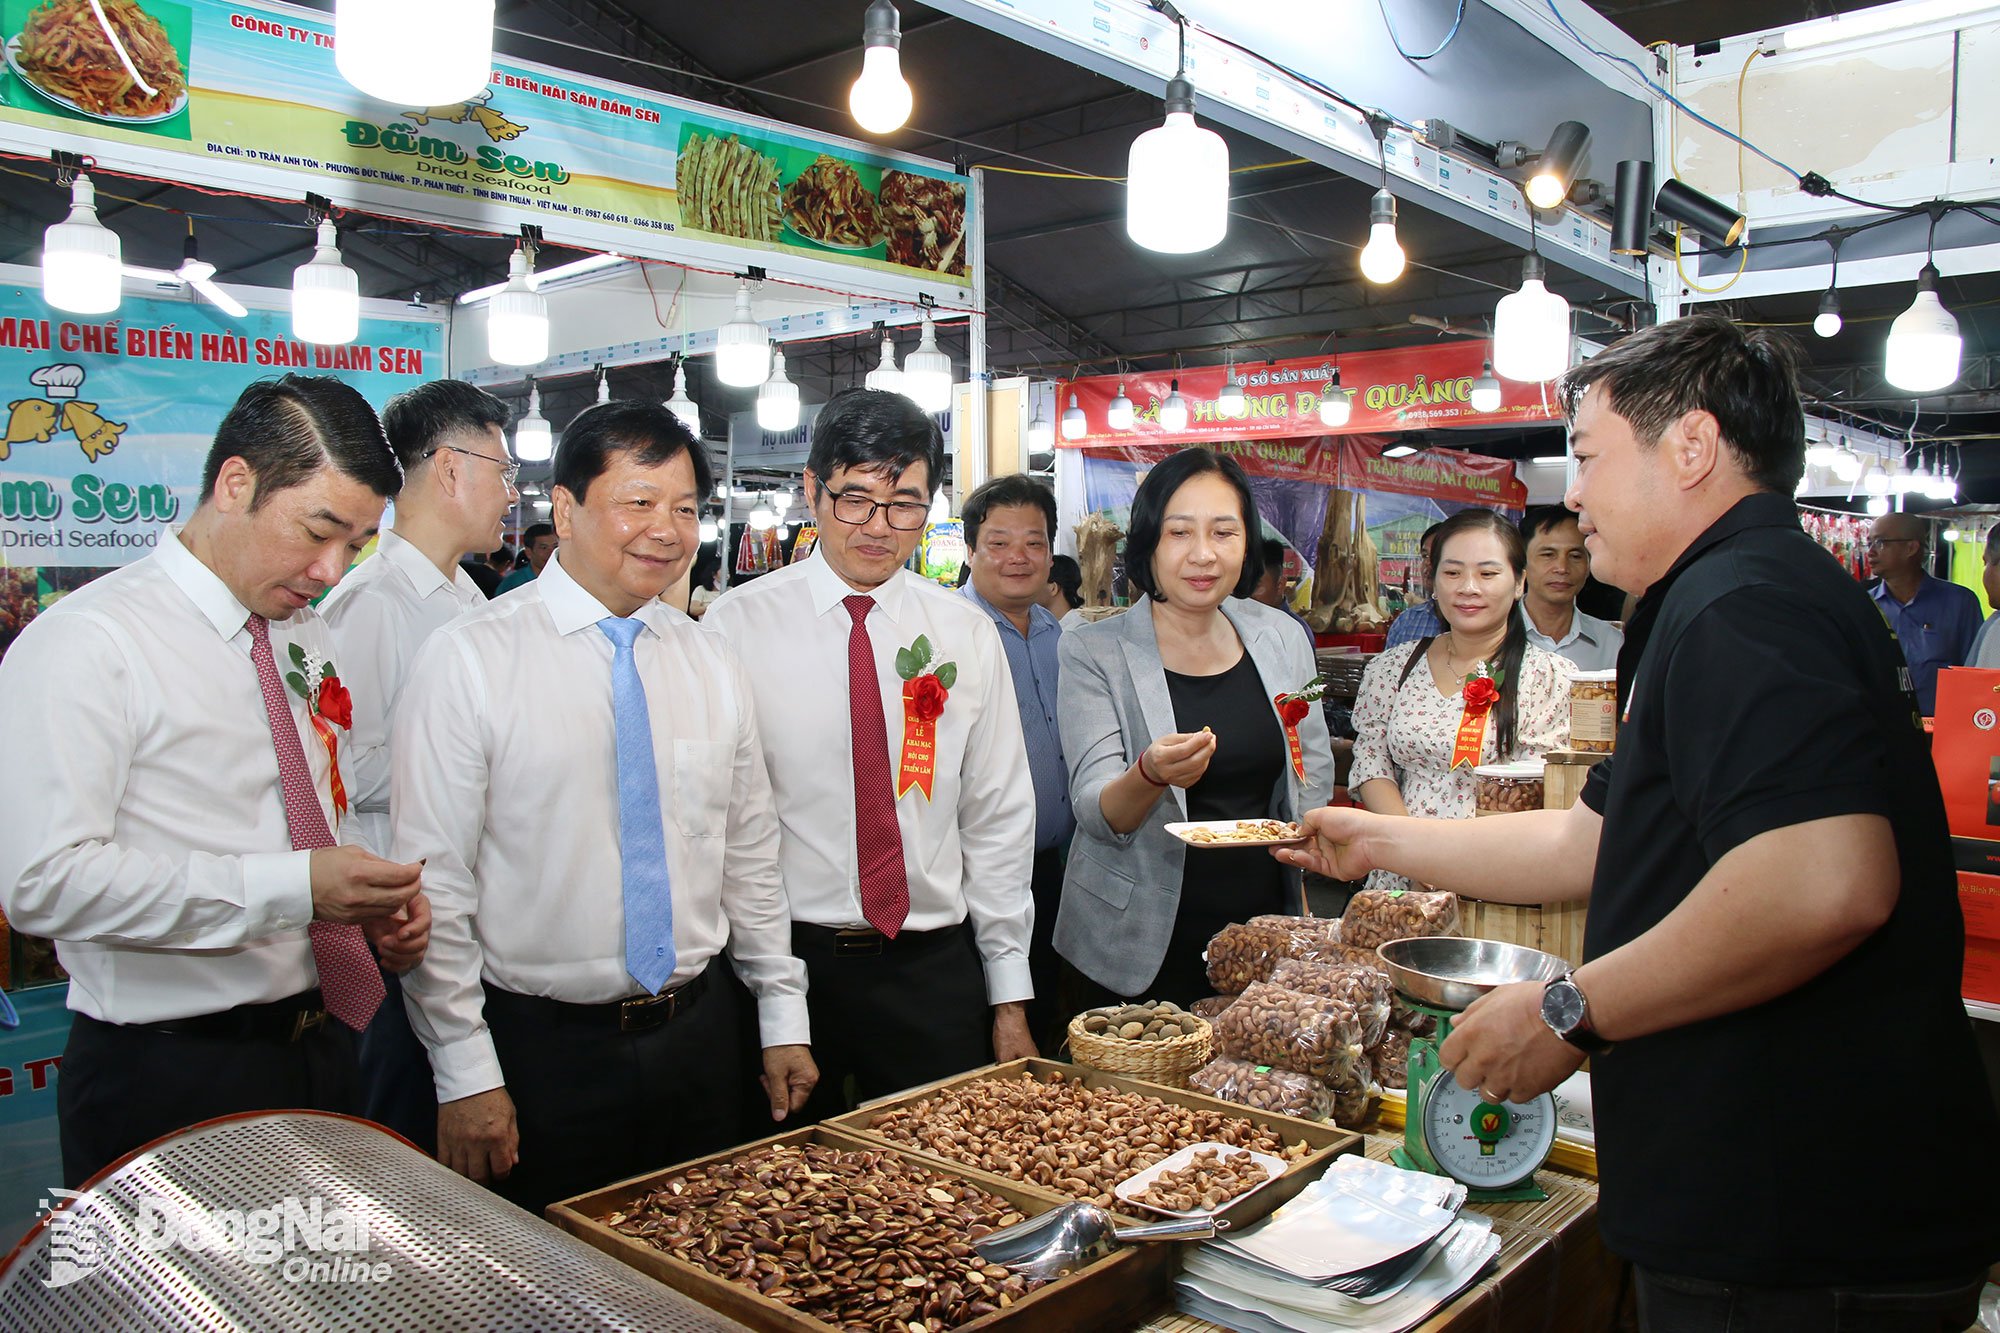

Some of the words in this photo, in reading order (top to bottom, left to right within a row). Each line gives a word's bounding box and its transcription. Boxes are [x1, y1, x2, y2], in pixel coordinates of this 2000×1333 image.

[231, 15, 283, 37] CÔNG
[288, 27, 309, 42] TY
[313, 33, 336, 49] TN
[505, 76, 538, 93] BIẾN
[635, 109, 660, 123] SEN
[417, 161, 468, 180] Dried
[472, 173, 551, 195] Seafood
[476, 145, 570, 184] Sen
[207, 143, 223, 155] ĐỊA
[246, 149, 257, 159] 1D
[283, 155, 300, 166] ANH
[411, 177, 423, 186] TP.
[424, 180, 444, 190] PHAN
[552, 202, 568, 212] NAM
[585, 209, 601, 218] 0987
[602, 212, 615, 222] 660
[616, 214, 629, 224] 618
[633, 217, 650, 227] 0366
[650, 220, 662, 230] 358
[663, 222, 675, 232] 085
[60, 318, 120, 355] CHẾ
[127, 324, 193, 360] BIẾN
[202, 329, 249, 365] HẢI
[256, 334, 308, 368] SẢN
[379, 346, 423, 374] SEN
[1366, 374, 1474, 411] QUẢNG
[71, 474, 178, 523] Sen
[2, 530, 63, 547] Dried
[68, 530, 158, 548] Seafood
